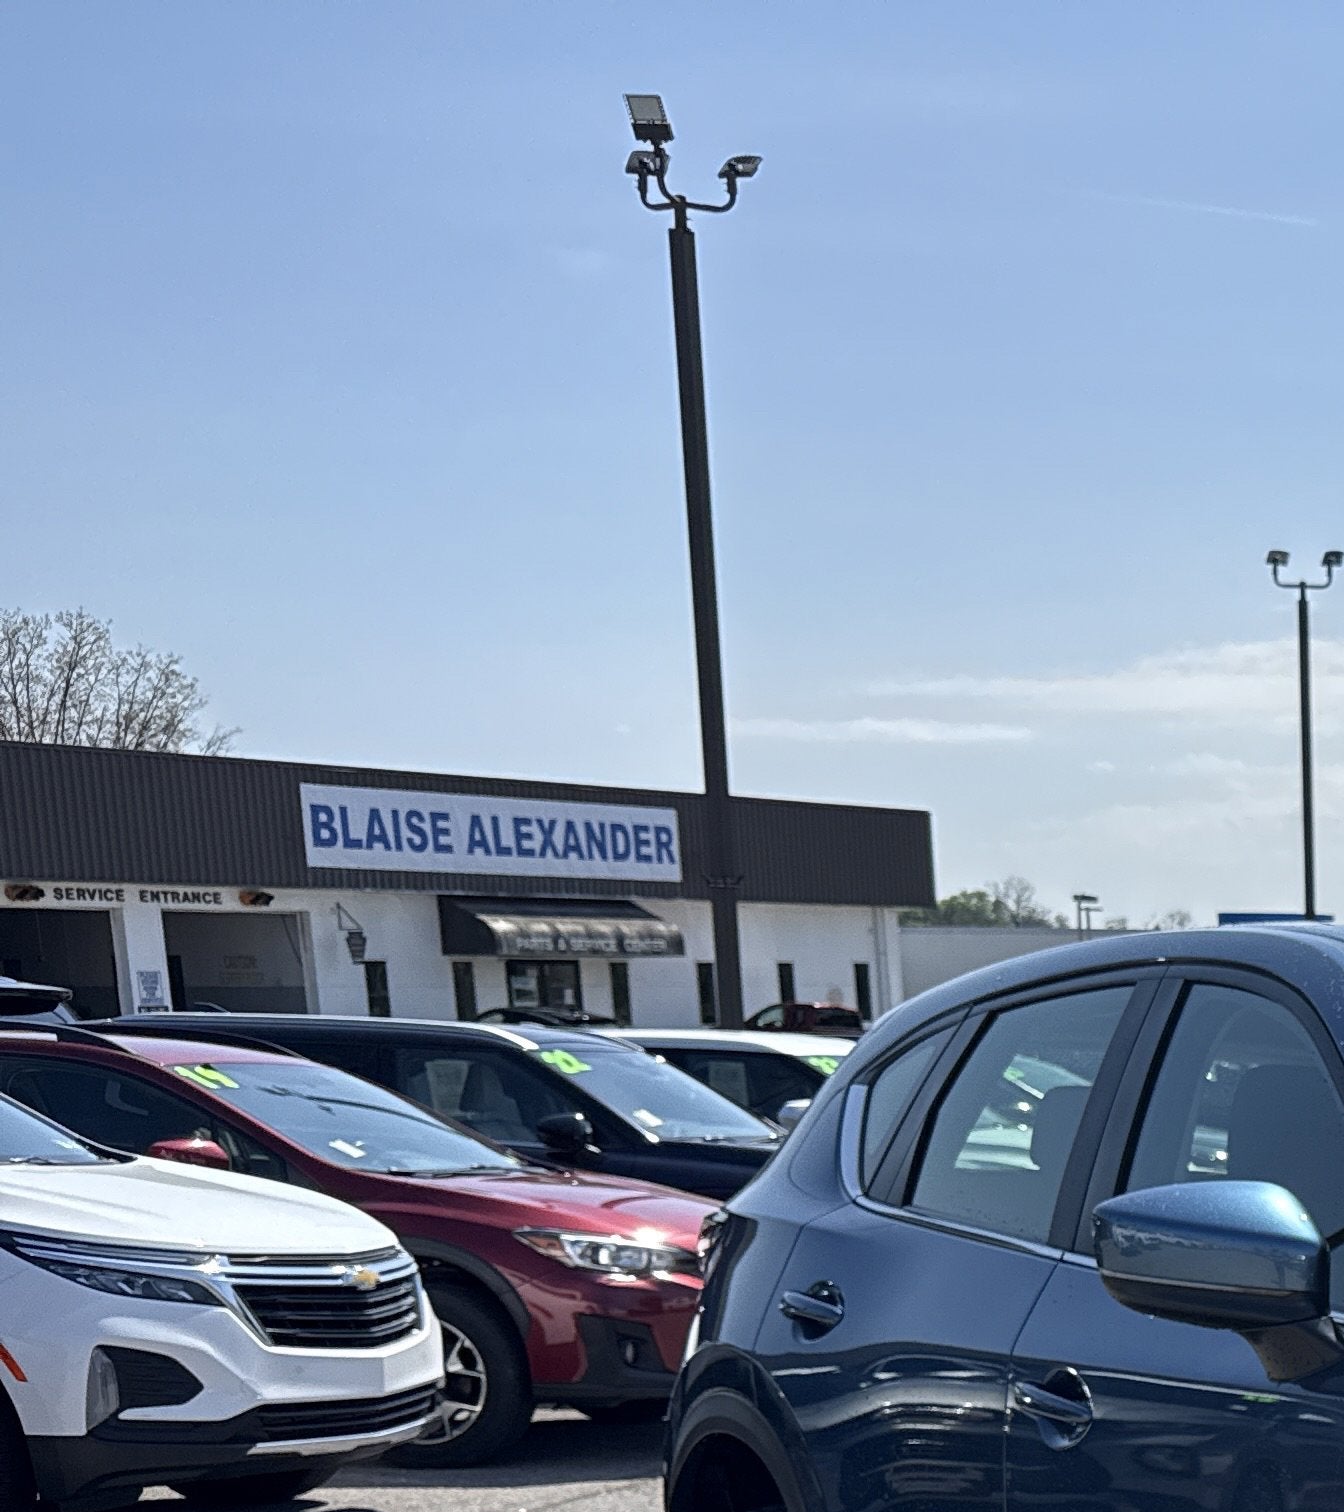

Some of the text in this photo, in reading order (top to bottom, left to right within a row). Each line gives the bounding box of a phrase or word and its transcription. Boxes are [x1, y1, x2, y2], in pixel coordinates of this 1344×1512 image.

[310, 804, 675, 865] BLAISE ALEXANDER
[53, 887, 223, 905] SERVICE ENTRANCE
